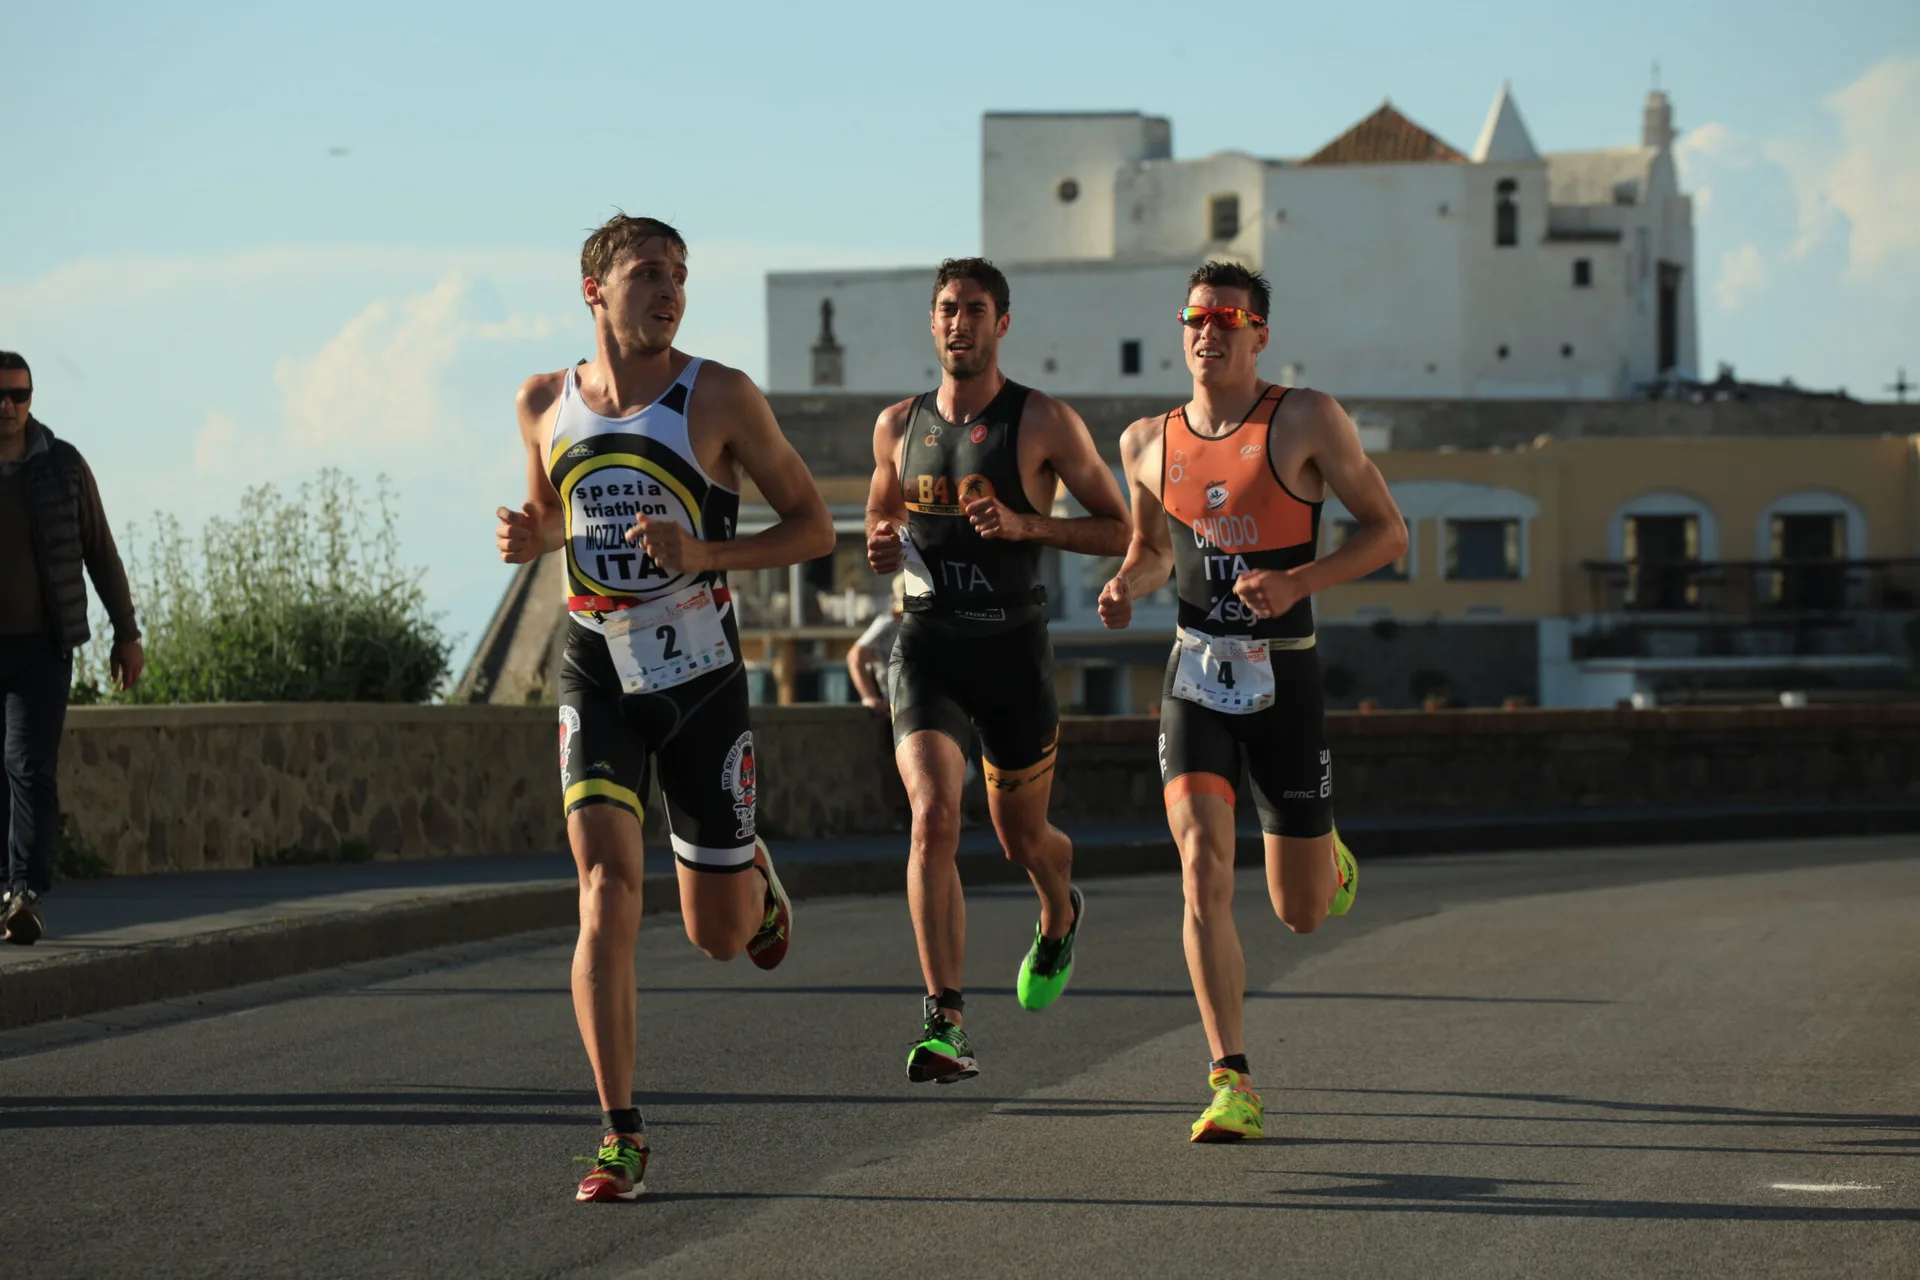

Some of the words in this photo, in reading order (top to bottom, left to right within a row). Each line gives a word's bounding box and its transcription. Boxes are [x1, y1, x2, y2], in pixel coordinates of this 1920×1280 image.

[576, 480, 662, 501] spezia
[917, 474, 949, 504] B4
[583, 501, 667, 518] triathlon
[1193, 513, 1259, 549] CHIODO
[595, 552, 669, 580] ITA
[940, 558, 994, 592] ITA
[1203, 554, 1251, 581] ITA
[656, 624, 683, 661] 2
[1217, 661, 1236, 690] 4
